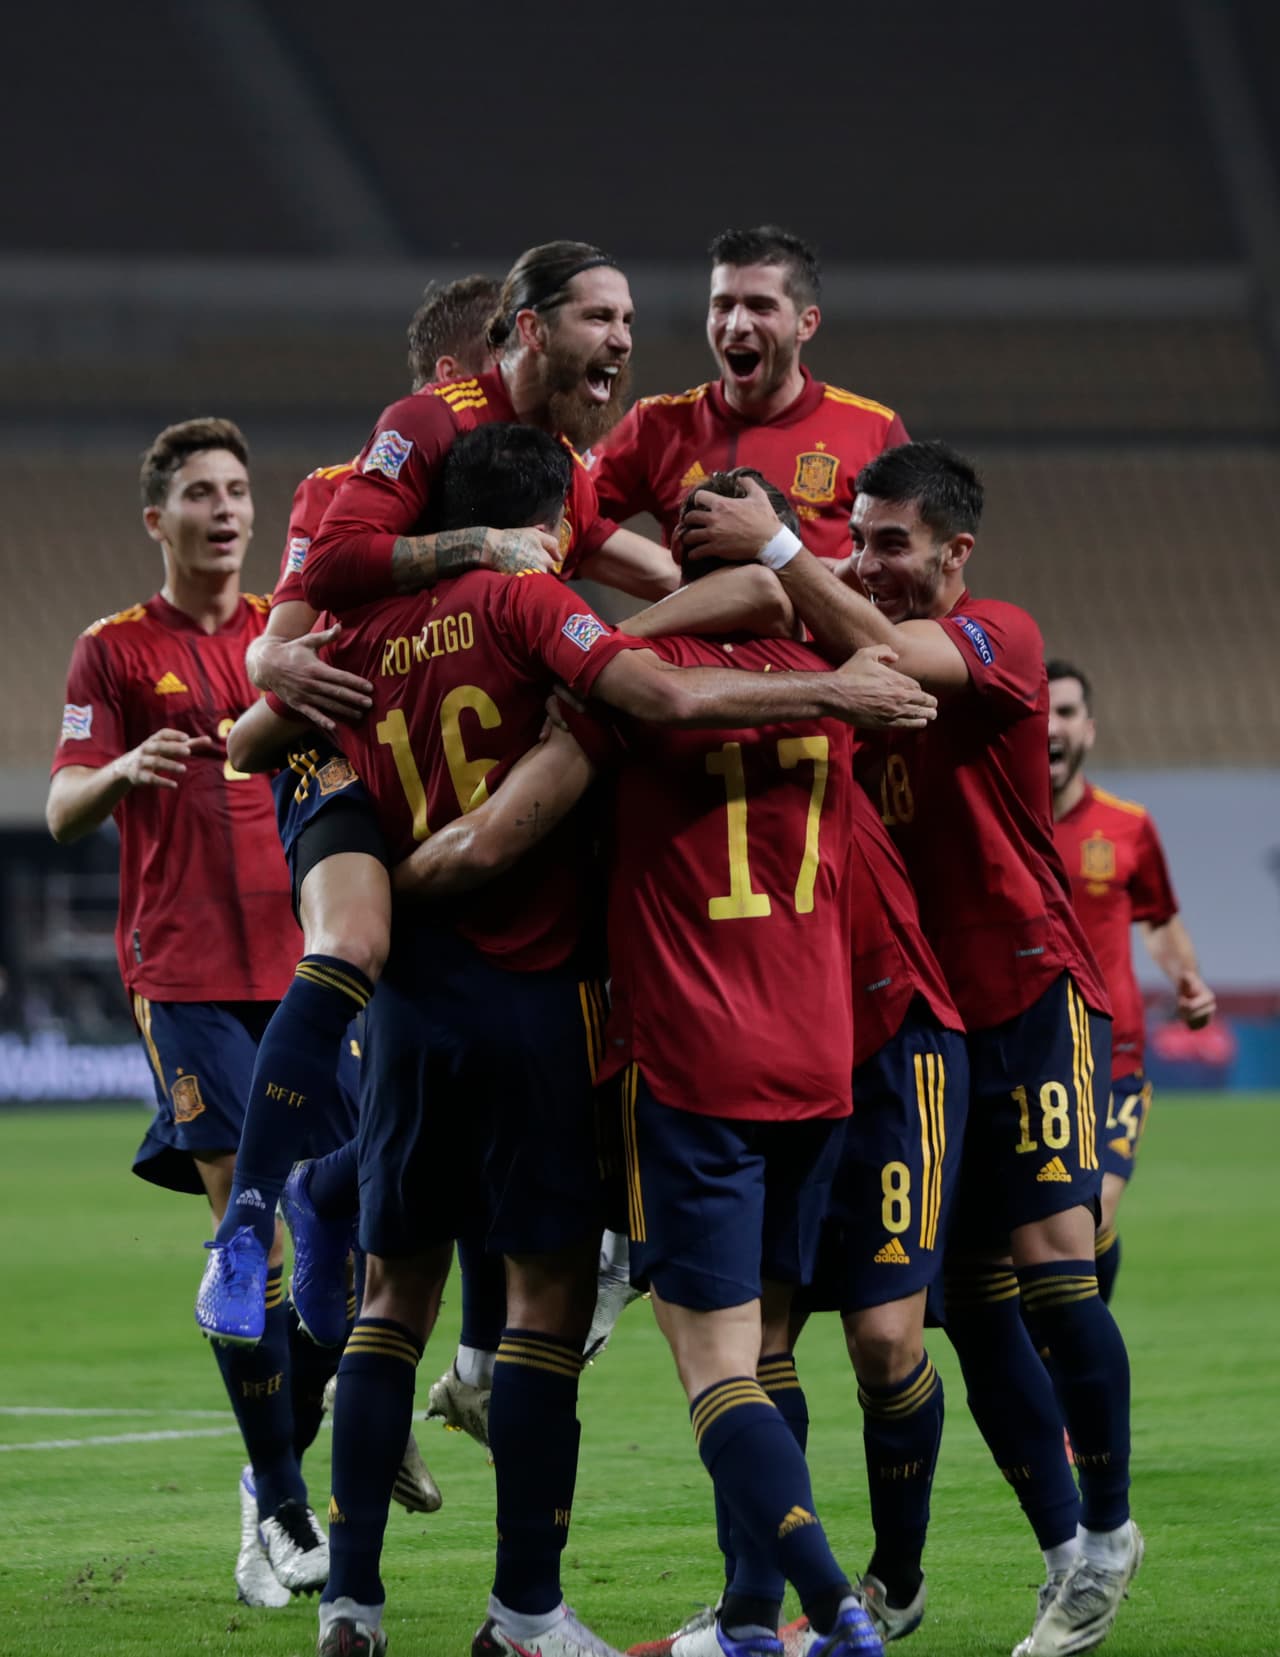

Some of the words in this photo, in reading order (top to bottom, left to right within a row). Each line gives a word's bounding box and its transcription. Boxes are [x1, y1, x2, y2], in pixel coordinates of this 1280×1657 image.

[964, 623, 992, 664] RESPECT
[376, 685, 502, 841] 16
[706, 736, 829, 920] 17
[1010, 1081, 1071, 1154] 18
[881, 1161, 911, 1234] 8
[1036, 1172, 1072, 1183] adidas
[874, 1254, 911, 1265] adidas
